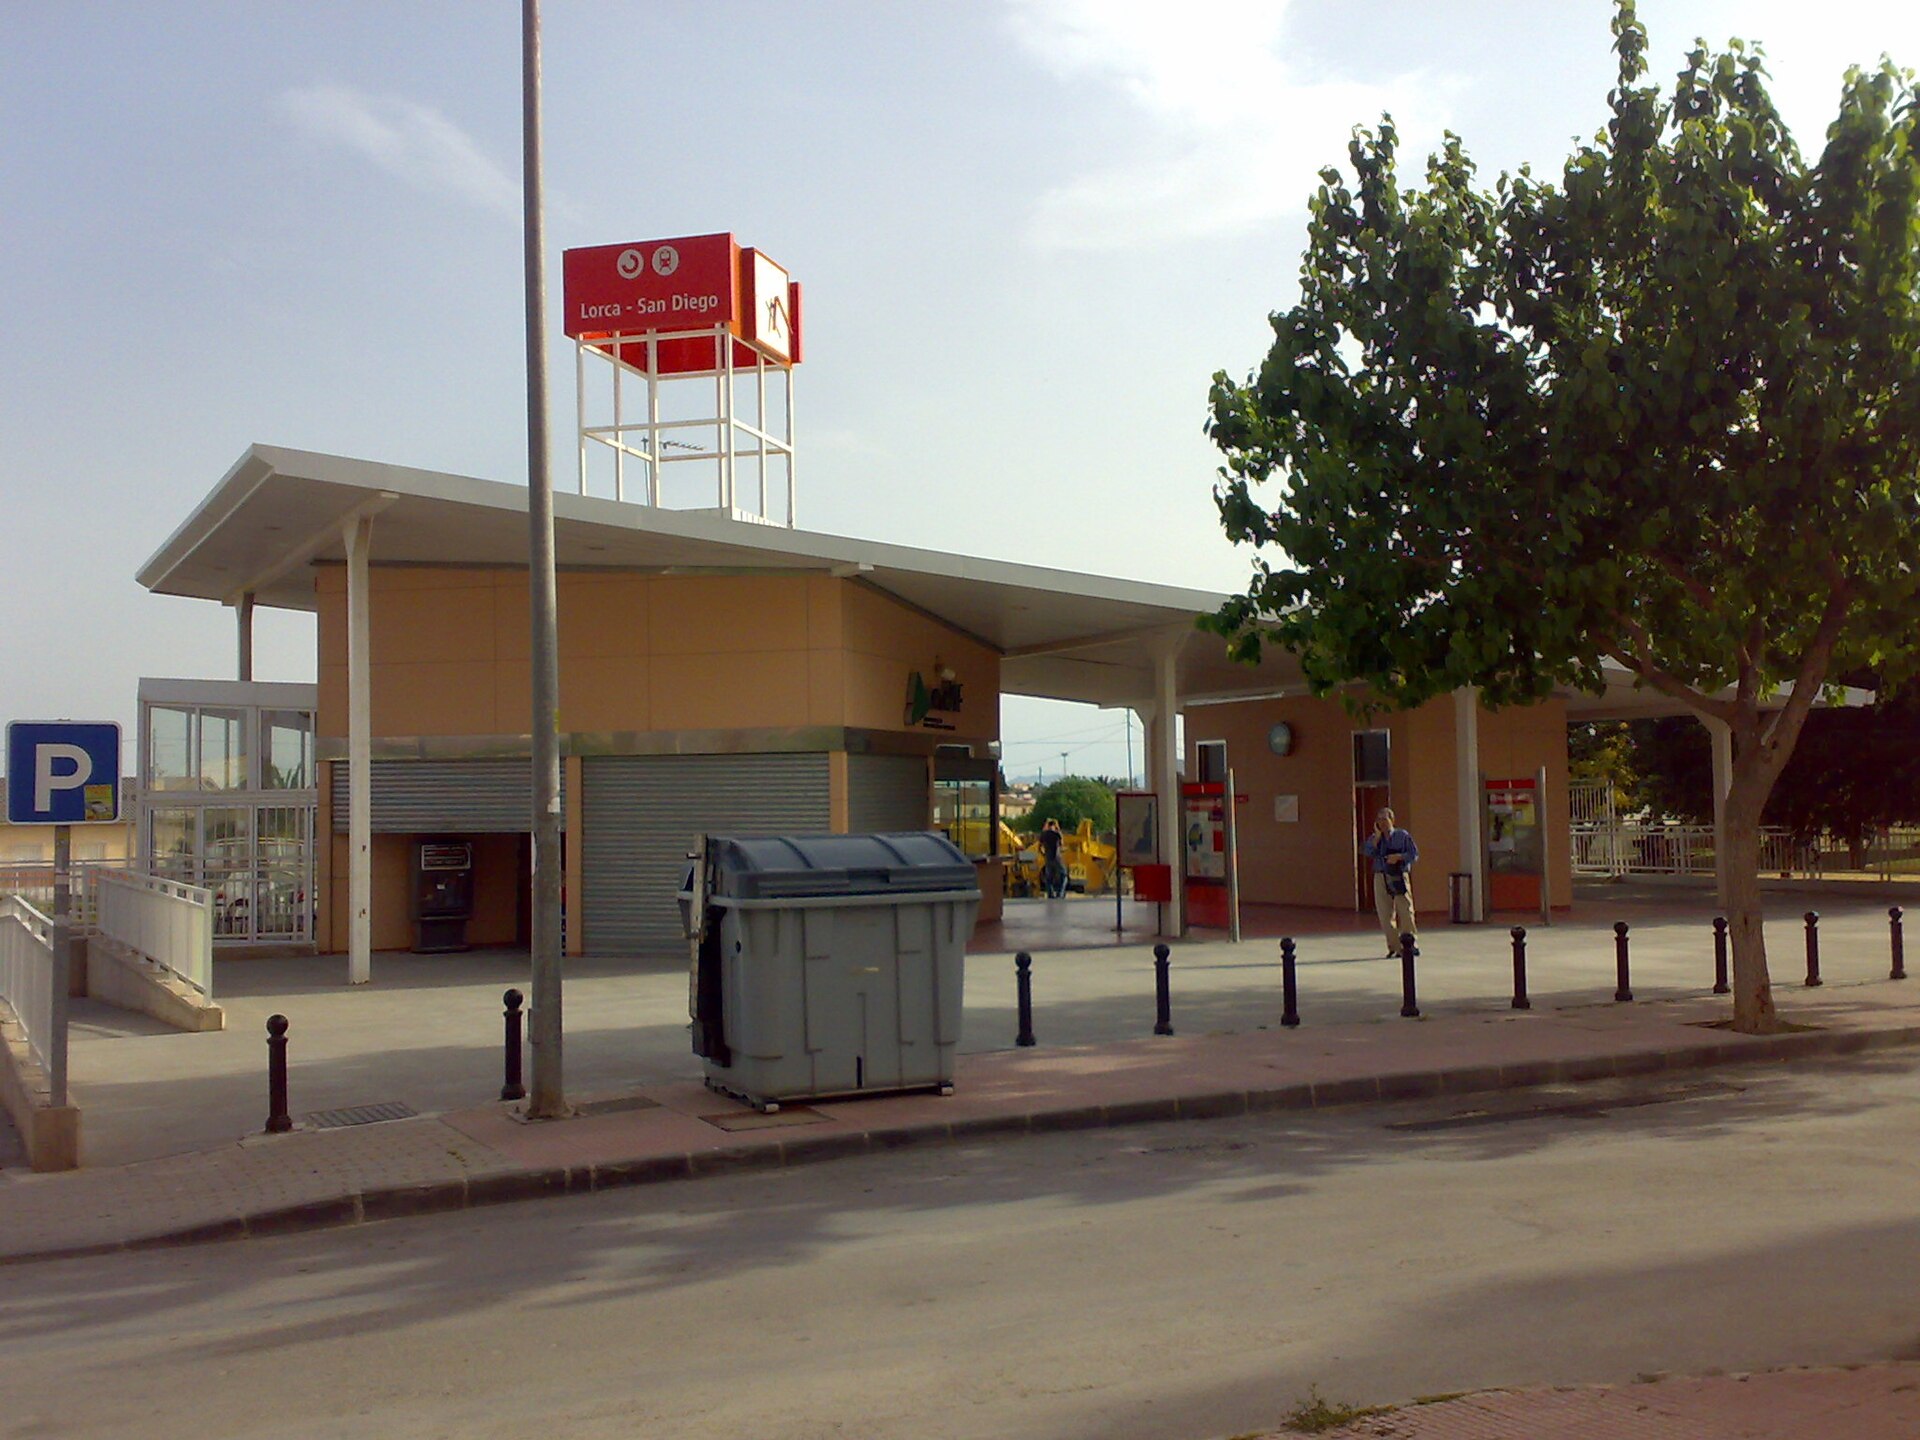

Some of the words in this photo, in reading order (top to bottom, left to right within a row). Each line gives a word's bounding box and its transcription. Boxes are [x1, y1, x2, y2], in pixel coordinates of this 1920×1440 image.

[580, 303, 621, 319] Lorca
[637, 298, 666, 314] San
[671, 293, 718, 313] Diego
[34, 743, 92, 812] P
